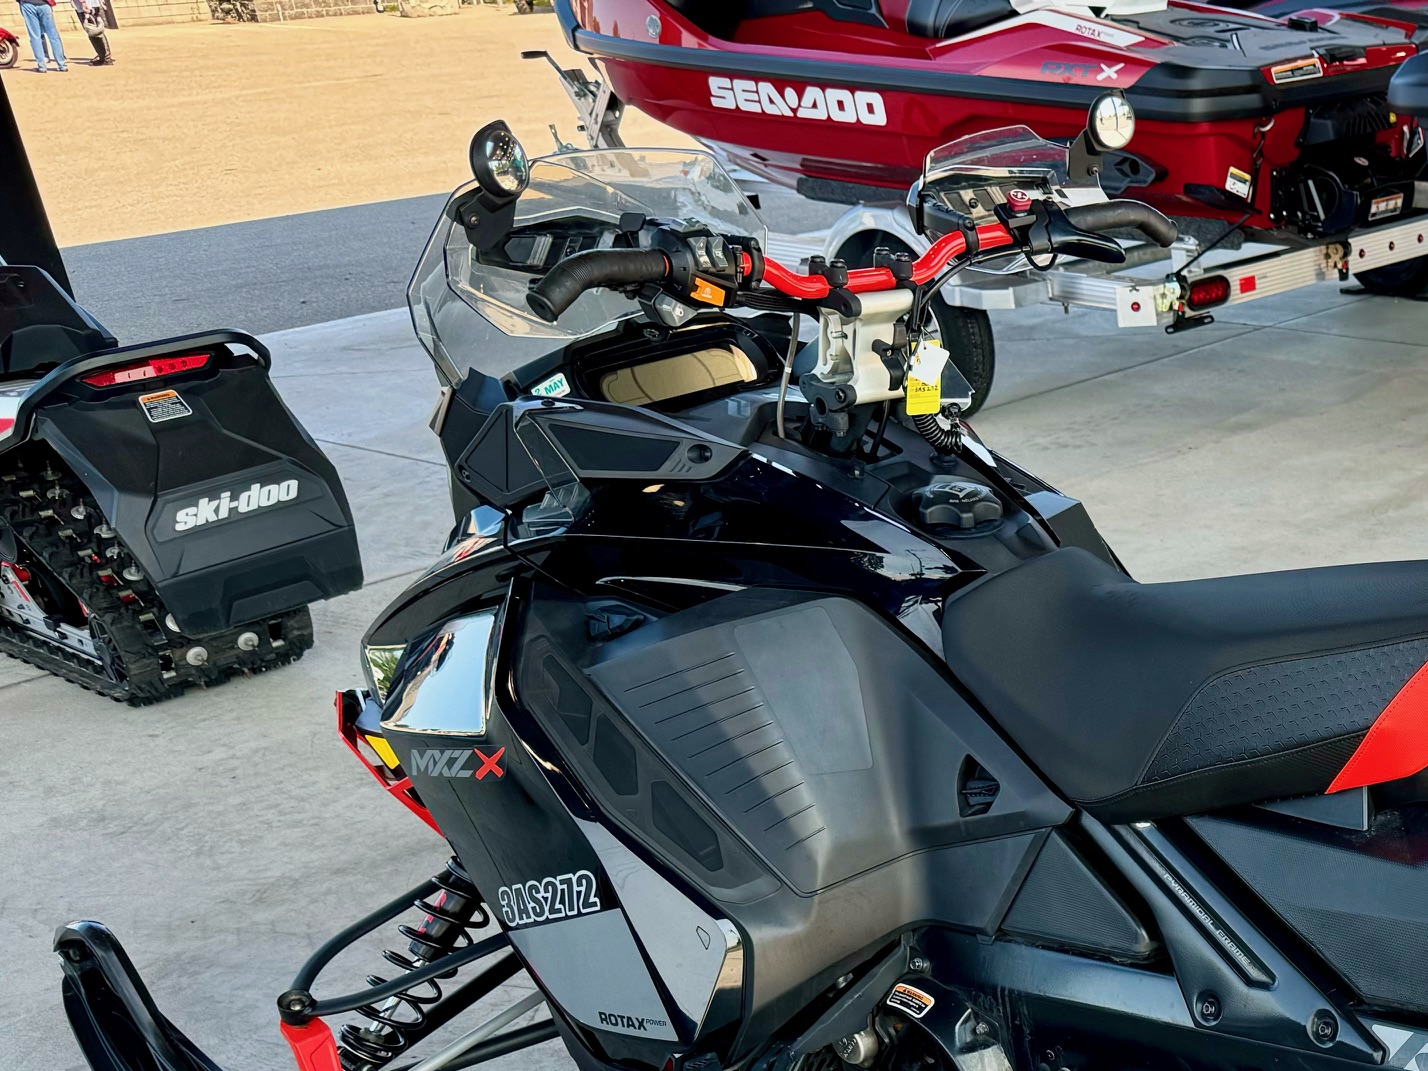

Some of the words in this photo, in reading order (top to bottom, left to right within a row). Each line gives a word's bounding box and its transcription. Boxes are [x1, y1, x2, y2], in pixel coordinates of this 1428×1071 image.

[1075, 24, 1102, 39] ROTAX
[544, 378, 564, 395] MAY
[175, 479, 299, 531] ski-doo
[410, 749, 474, 777] MXZ
[473, 746, 506, 780] X
[498, 869, 600, 927] 3AS272
[1163, 873, 1217, 931] PYRAMIDAL
[1216, 929, 1251, 966] FRAME
[598, 1011, 648, 1031] ROTAX
[645, 1018, 667, 1027] POWER
